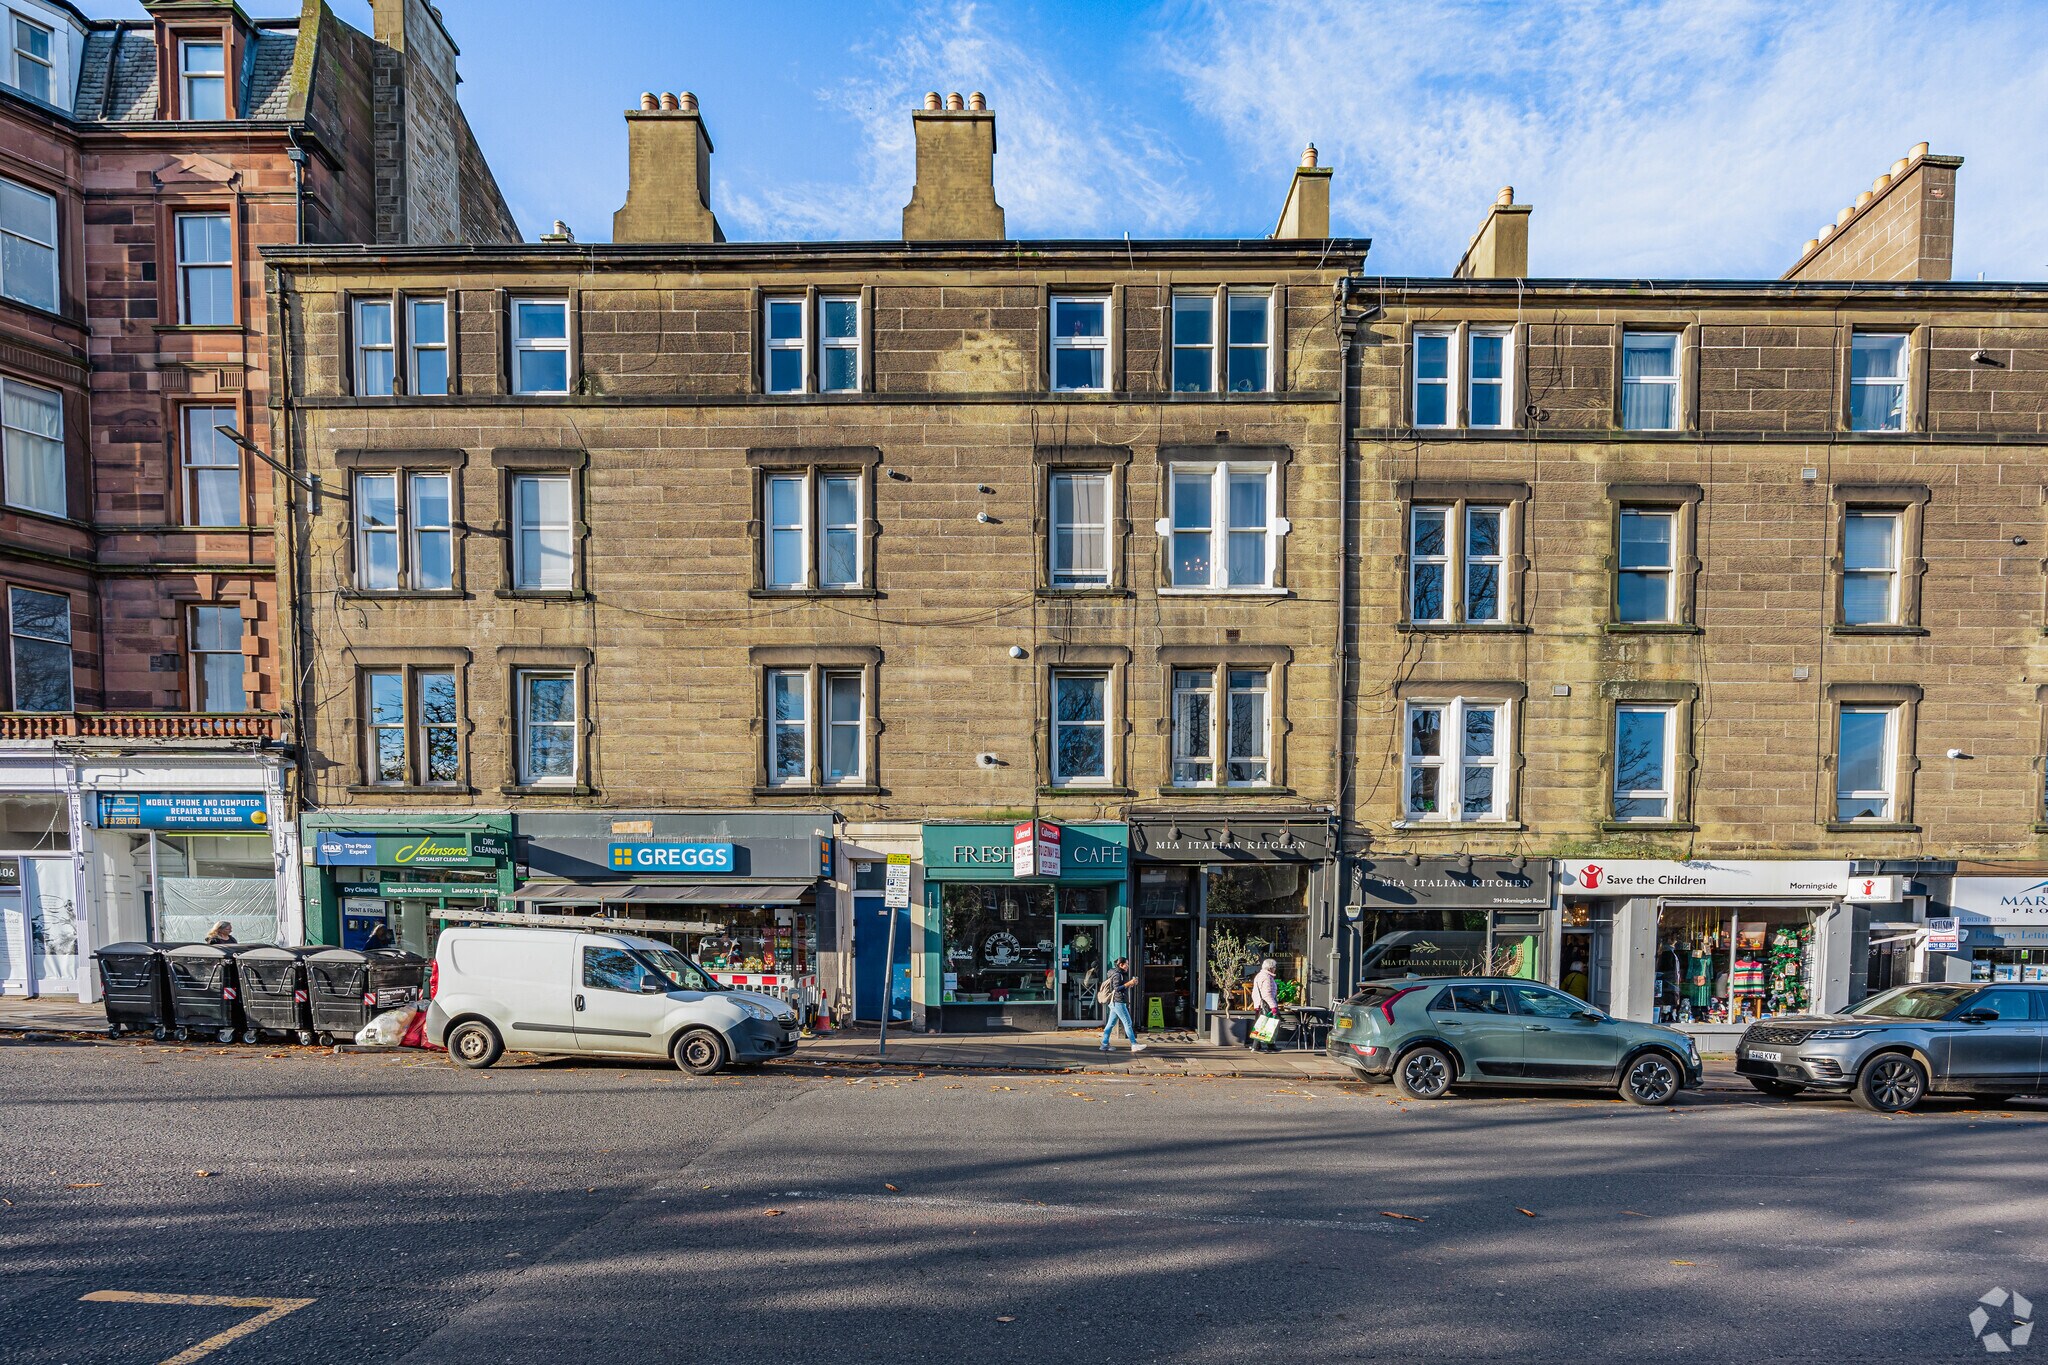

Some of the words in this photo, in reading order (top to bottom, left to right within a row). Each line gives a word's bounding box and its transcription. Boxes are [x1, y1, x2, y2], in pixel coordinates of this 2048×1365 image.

[322, 844, 341, 852] MAX
[395, 836, 468, 863] Johnsons
[474, 845, 505, 855] CLEANING
[1156, 841, 1180, 850] MIA
[1188, 841, 1241, 850] ITALIAN
[1247, 841, 1306, 850] KITCHEN
[637, 848, 727, 866] GREGGS
[953, 845, 1014, 864] FRESH
[1074, 841, 1123, 863] CAFÉ
[1382, 879, 1405, 887] MIA
[1413, 879, 1466, 887] ITALIAN
[1472, 879, 1531, 887] KITCHEN
[1606, 874, 1633, 885] Save
[1636, 875, 1655, 885] the
[1658, 875, 1706, 885] Children
[344, 886, 354, 894] Dry
[354, 886, 378, 894] Cleaning
[451, 887, 473, 895] Laundry
[1789, 882, 1838, 891] Morningside
[1975, 930, 2017, 940] Property
